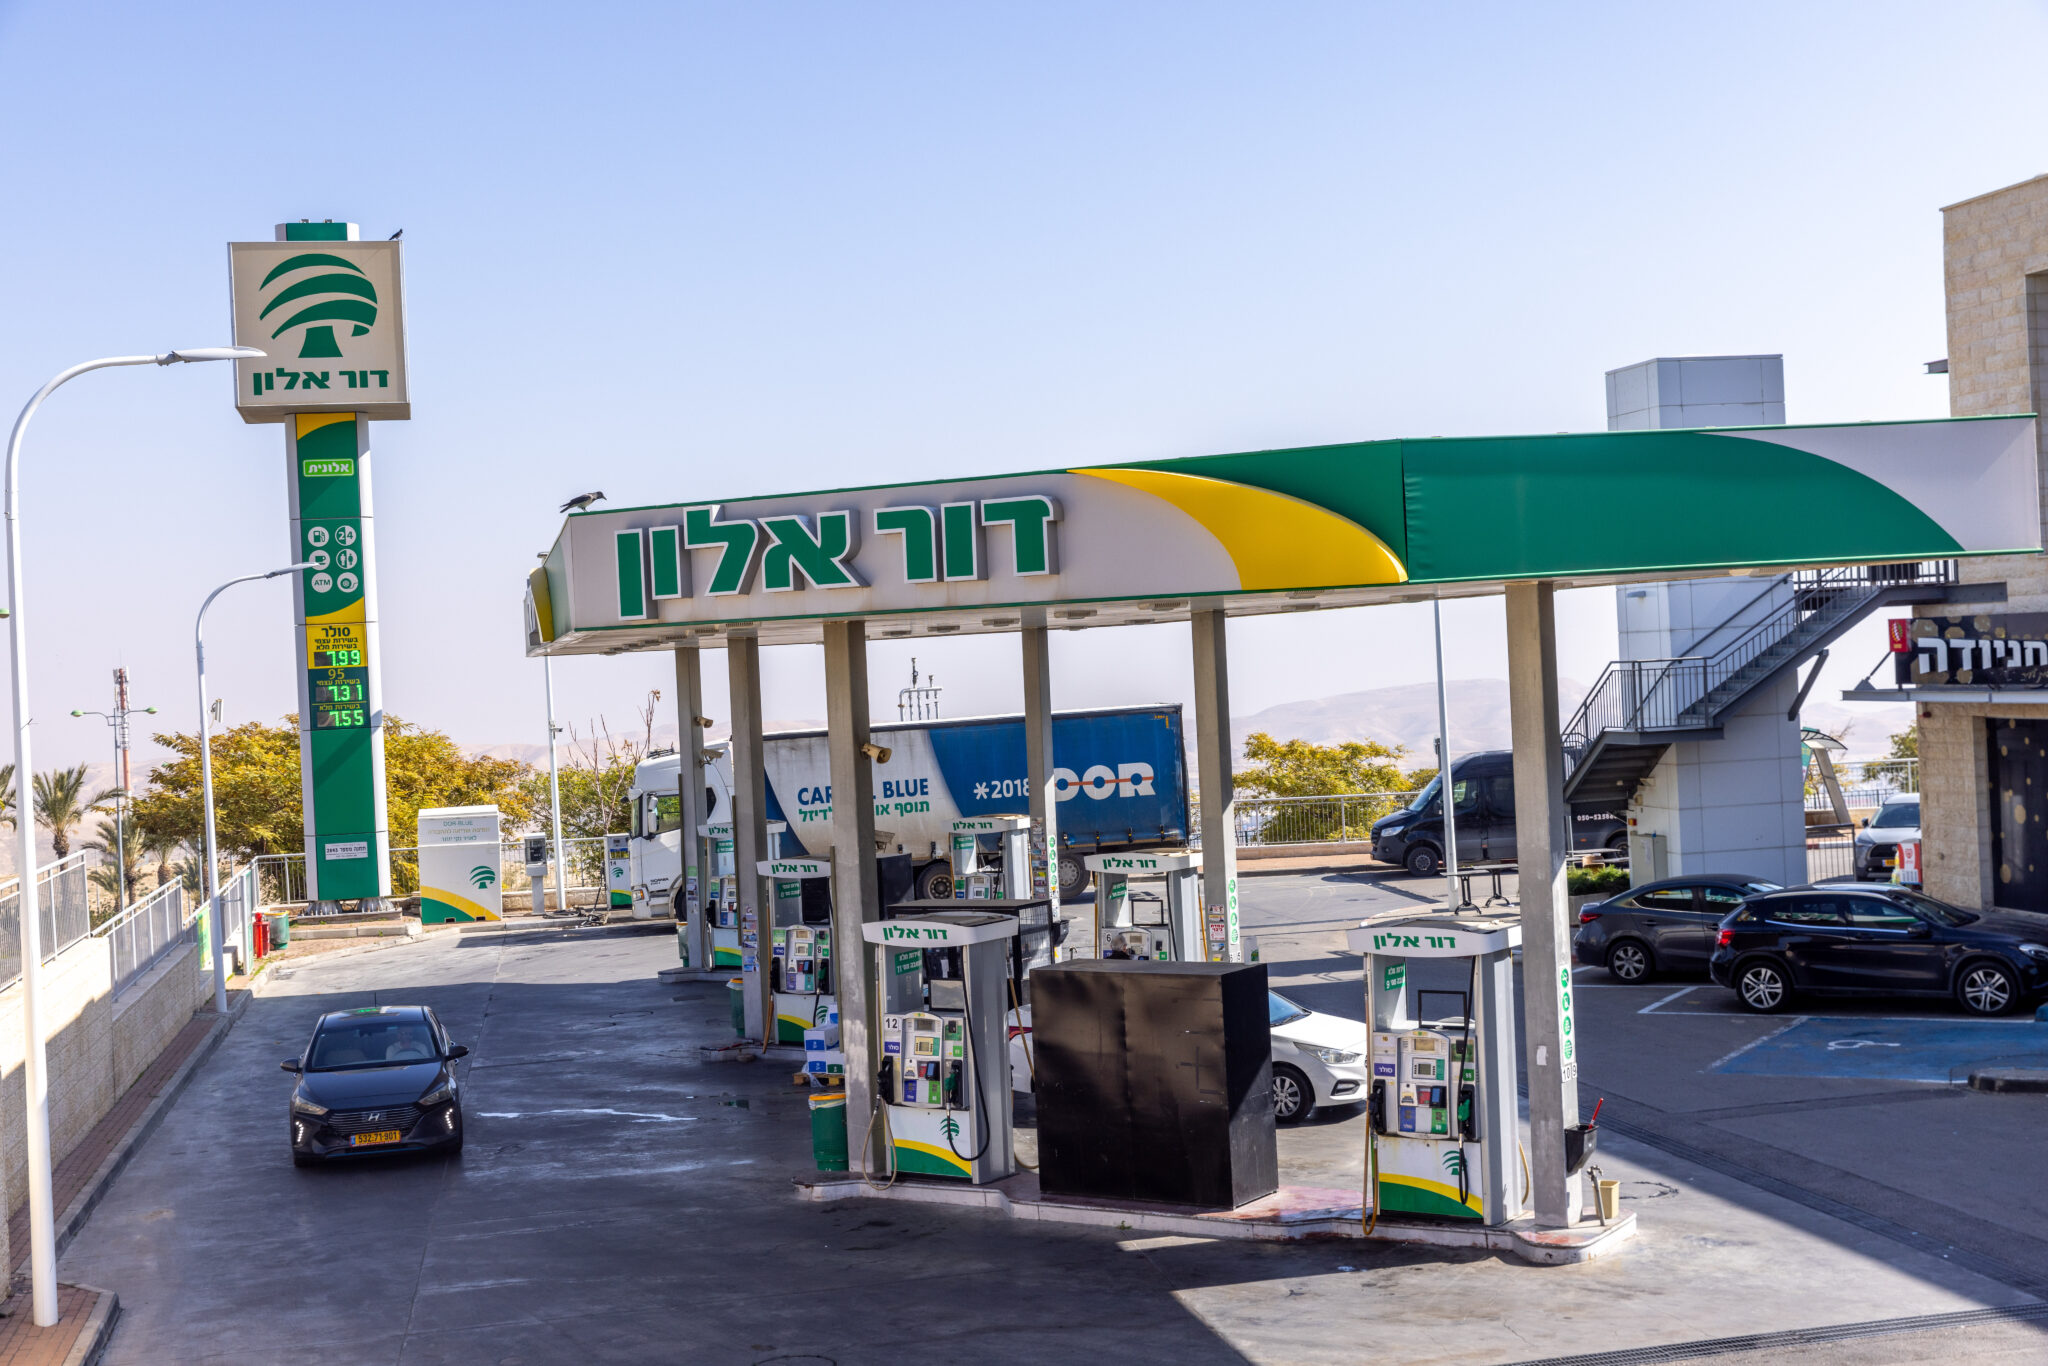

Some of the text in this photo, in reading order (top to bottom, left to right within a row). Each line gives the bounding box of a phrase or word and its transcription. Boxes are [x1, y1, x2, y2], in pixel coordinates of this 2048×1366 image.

[253, 367, 390, 396] דור אלון
[308, 461, 350, 473] אלונית
[614, 494, 1059, 622] דור אלון
[321, 625, 351, 637] סולר
[326, 650, 361, 666] 7.99
[328, 668, 345, 680] 95
[328, 685, 363, 702] 7.31
[329, 710, 364, 727] 7.55
[882, 778, 929, 799] BLUE
[894, 801, 930, 817] תוסף
[952, 821, 976, 831] אלון
[771, 862, 818, 875] דור אלון
[1102, 856, 1157, 870] דור אלון
[883, 924, 948, 940] דור אלון
[1106, 934, 1112, 943] 6
[1373, 932, 1456, 950] דור אלון
[885, 1018, 898, 1029] 12
[1378, 1066, 1393, 1074] סולר
